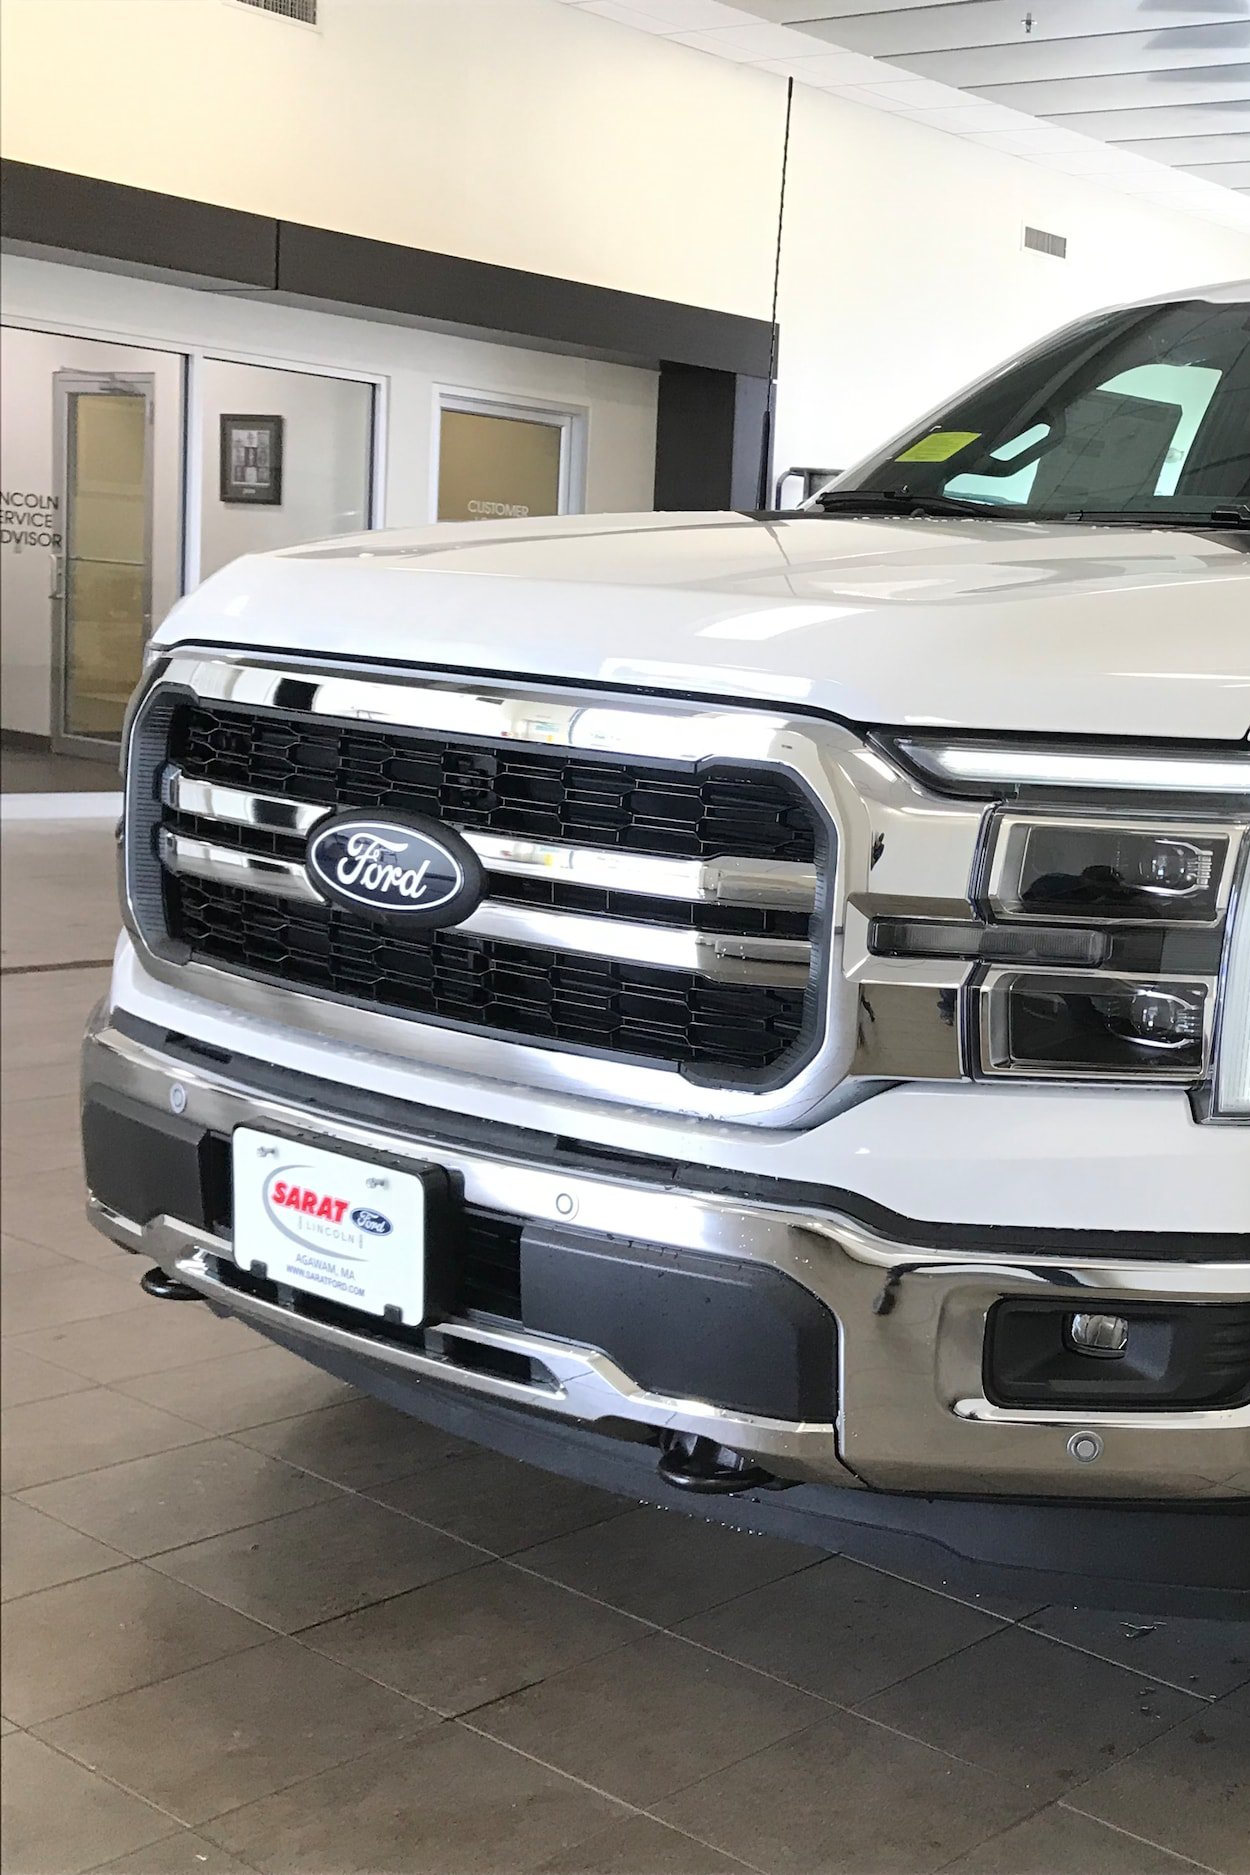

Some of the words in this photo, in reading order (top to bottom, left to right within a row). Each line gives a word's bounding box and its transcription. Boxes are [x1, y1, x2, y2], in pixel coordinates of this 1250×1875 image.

[467, 500, 529, 517] CUSTOMER
[336, 832, 432, 899] Ford
[272, 1182, 349, 1223] SARAT
[306, 1222, 355, 1244] LINCOLN
[356, 1210, 387, 1233] Ford
[286, 1264, 366, 1297] WWW.SARATFORD.COM
[340, 1267, 356, 1281] MA
